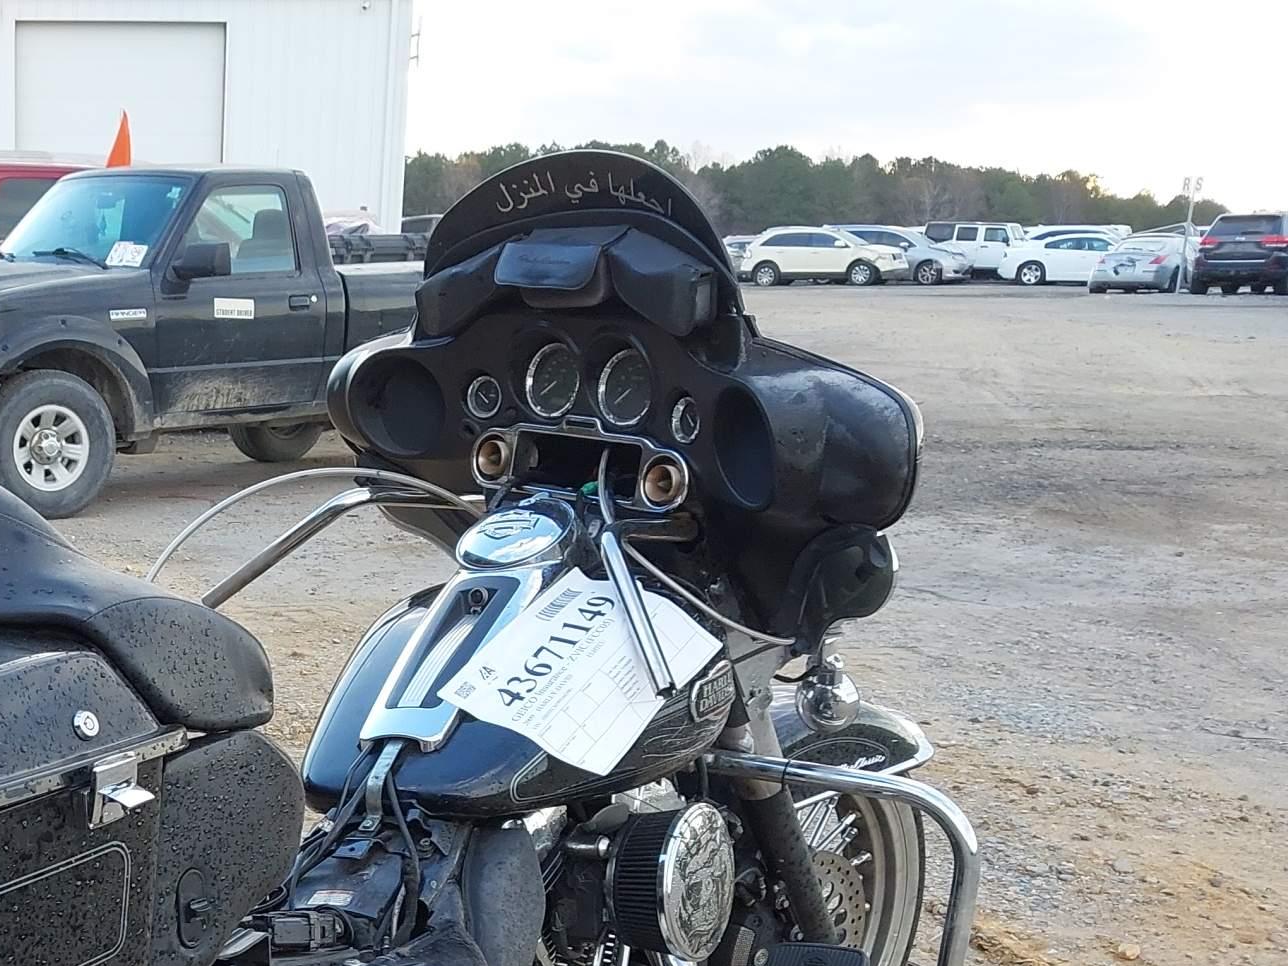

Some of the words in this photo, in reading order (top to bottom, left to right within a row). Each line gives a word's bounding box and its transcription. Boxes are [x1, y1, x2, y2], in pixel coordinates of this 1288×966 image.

[496, 170, 555, 213] المنزل
[564, 171, 599, 204] في
[497, 595, 615, 707] 43671149
[511, 696, 538, 722] GEICO
